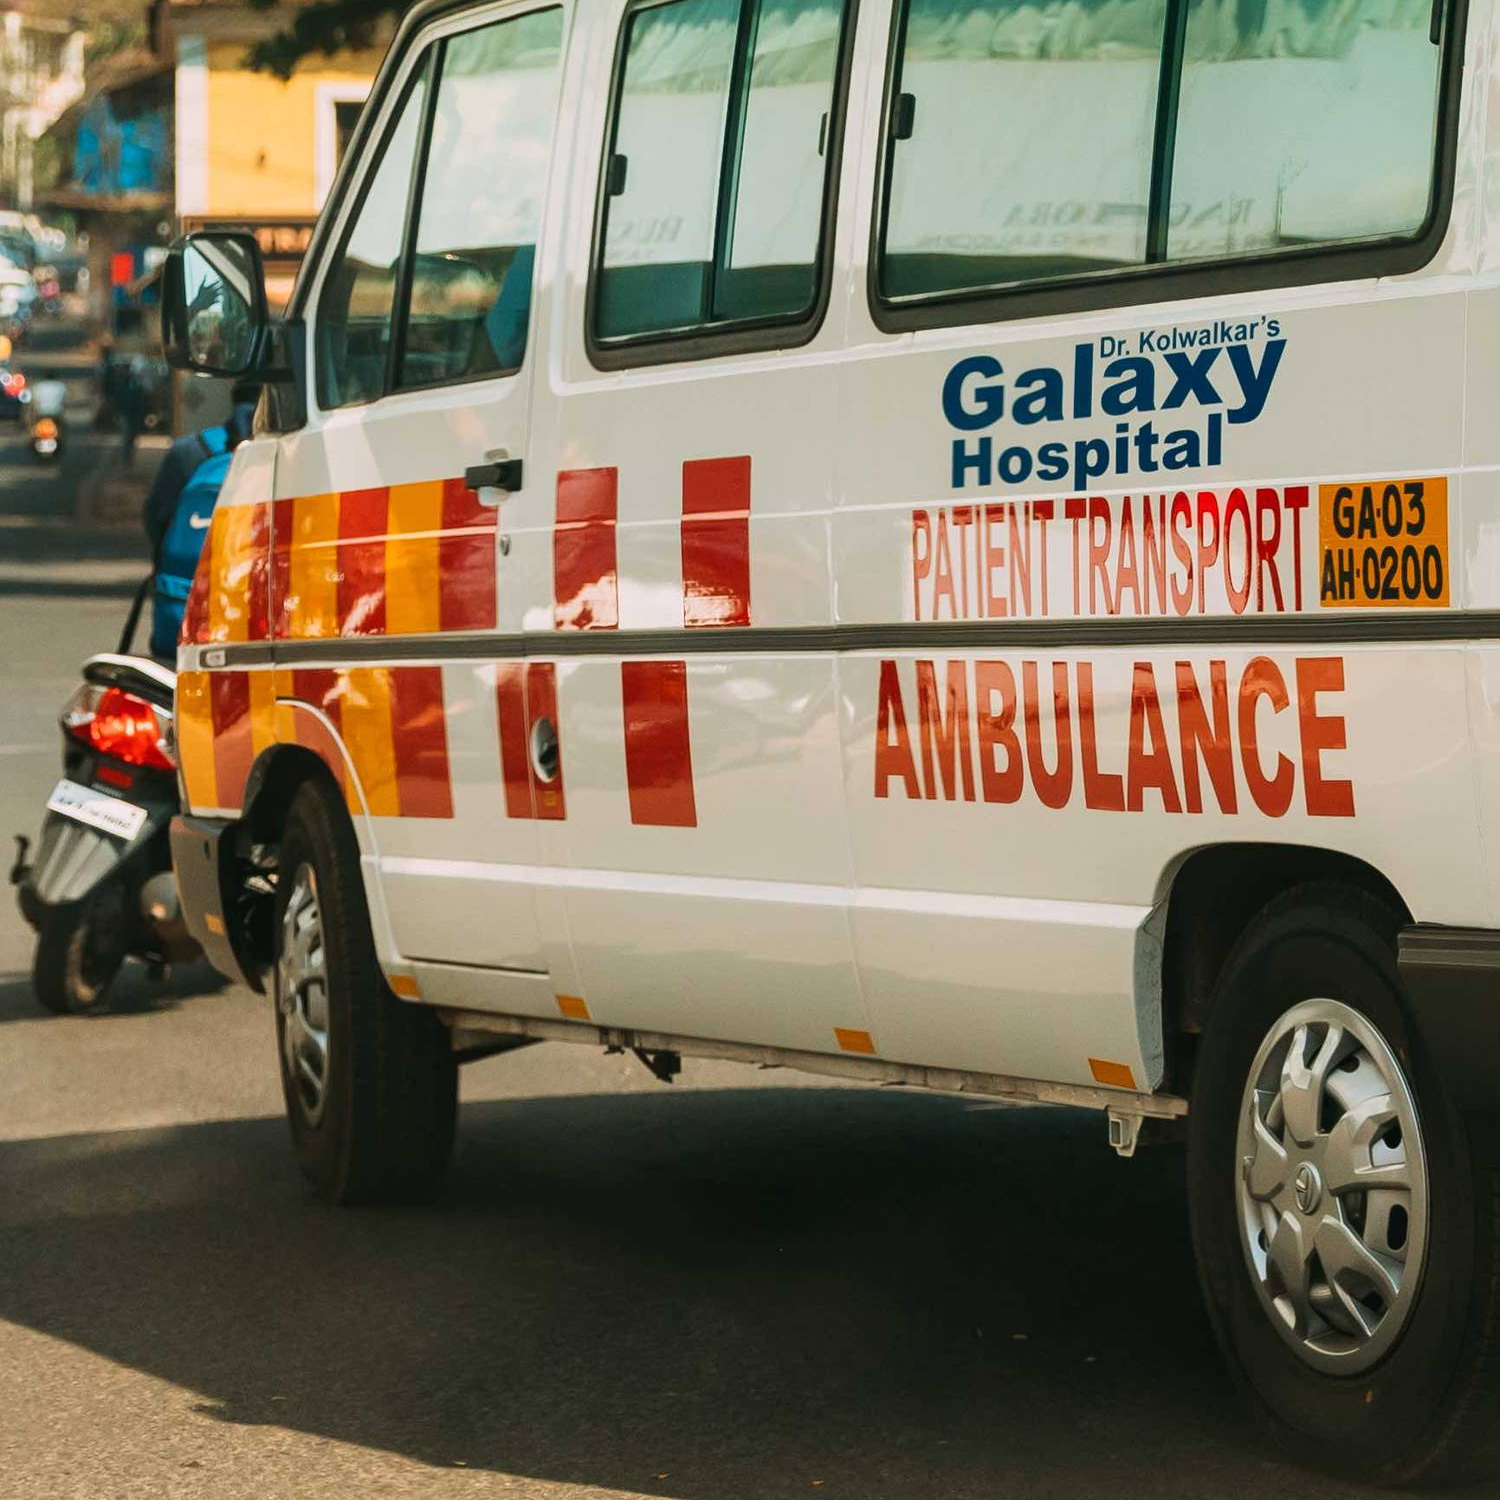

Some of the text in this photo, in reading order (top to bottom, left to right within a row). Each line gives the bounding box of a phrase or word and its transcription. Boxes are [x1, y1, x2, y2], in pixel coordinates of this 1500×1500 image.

[1100, 315, 1281, 359] Dr. Kolwalkar's
[942, 339, 1288, 431] Galaxy
[952, 412, 1223, 491] Hospital
[911, 485, 1310, 621] PATIENT TRANSPORT
[874, 655, 1357, 818] AMBULANCE
